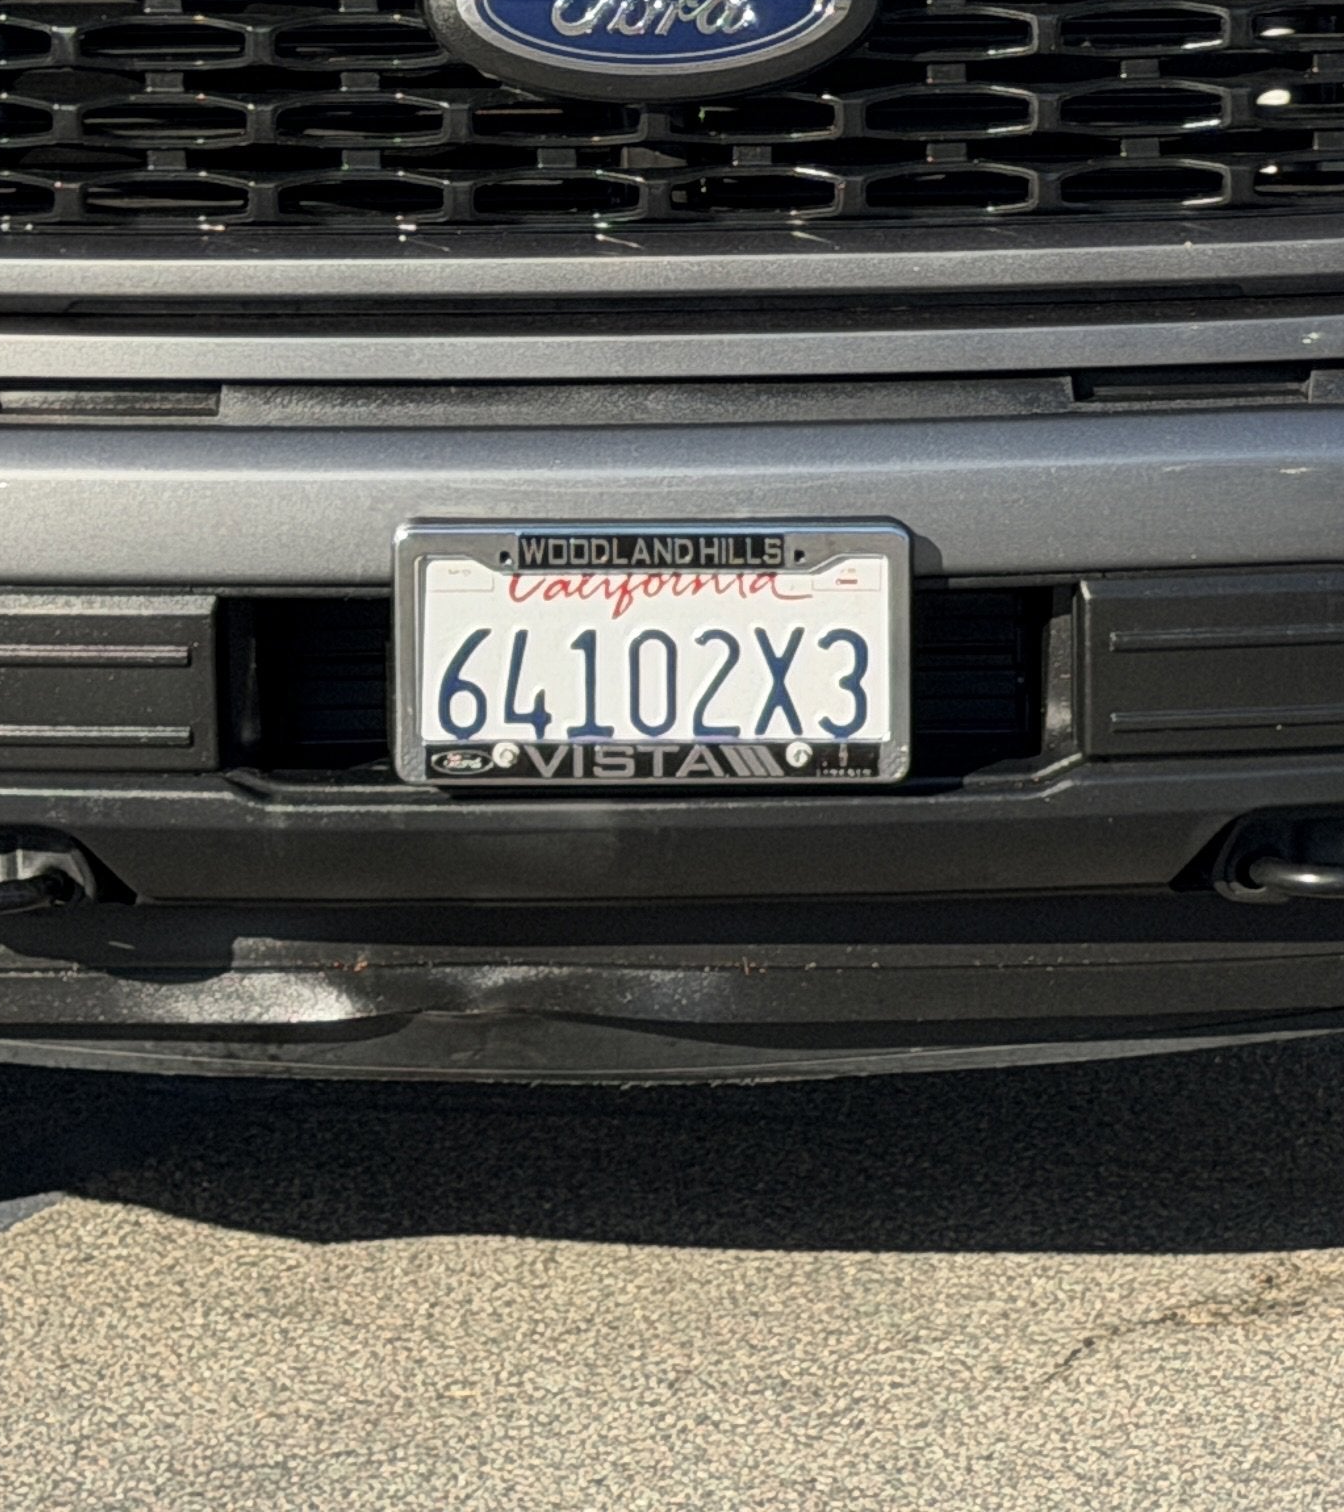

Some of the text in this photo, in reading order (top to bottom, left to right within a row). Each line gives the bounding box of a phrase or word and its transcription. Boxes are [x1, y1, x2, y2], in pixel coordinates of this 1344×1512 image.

[521, 537, 783, 566] WOODLAND HILLS
[508, 571, 814, 620] California
[437, 627, 870, 741] 64102X3
[524, 743, 731, 778] VISTA
